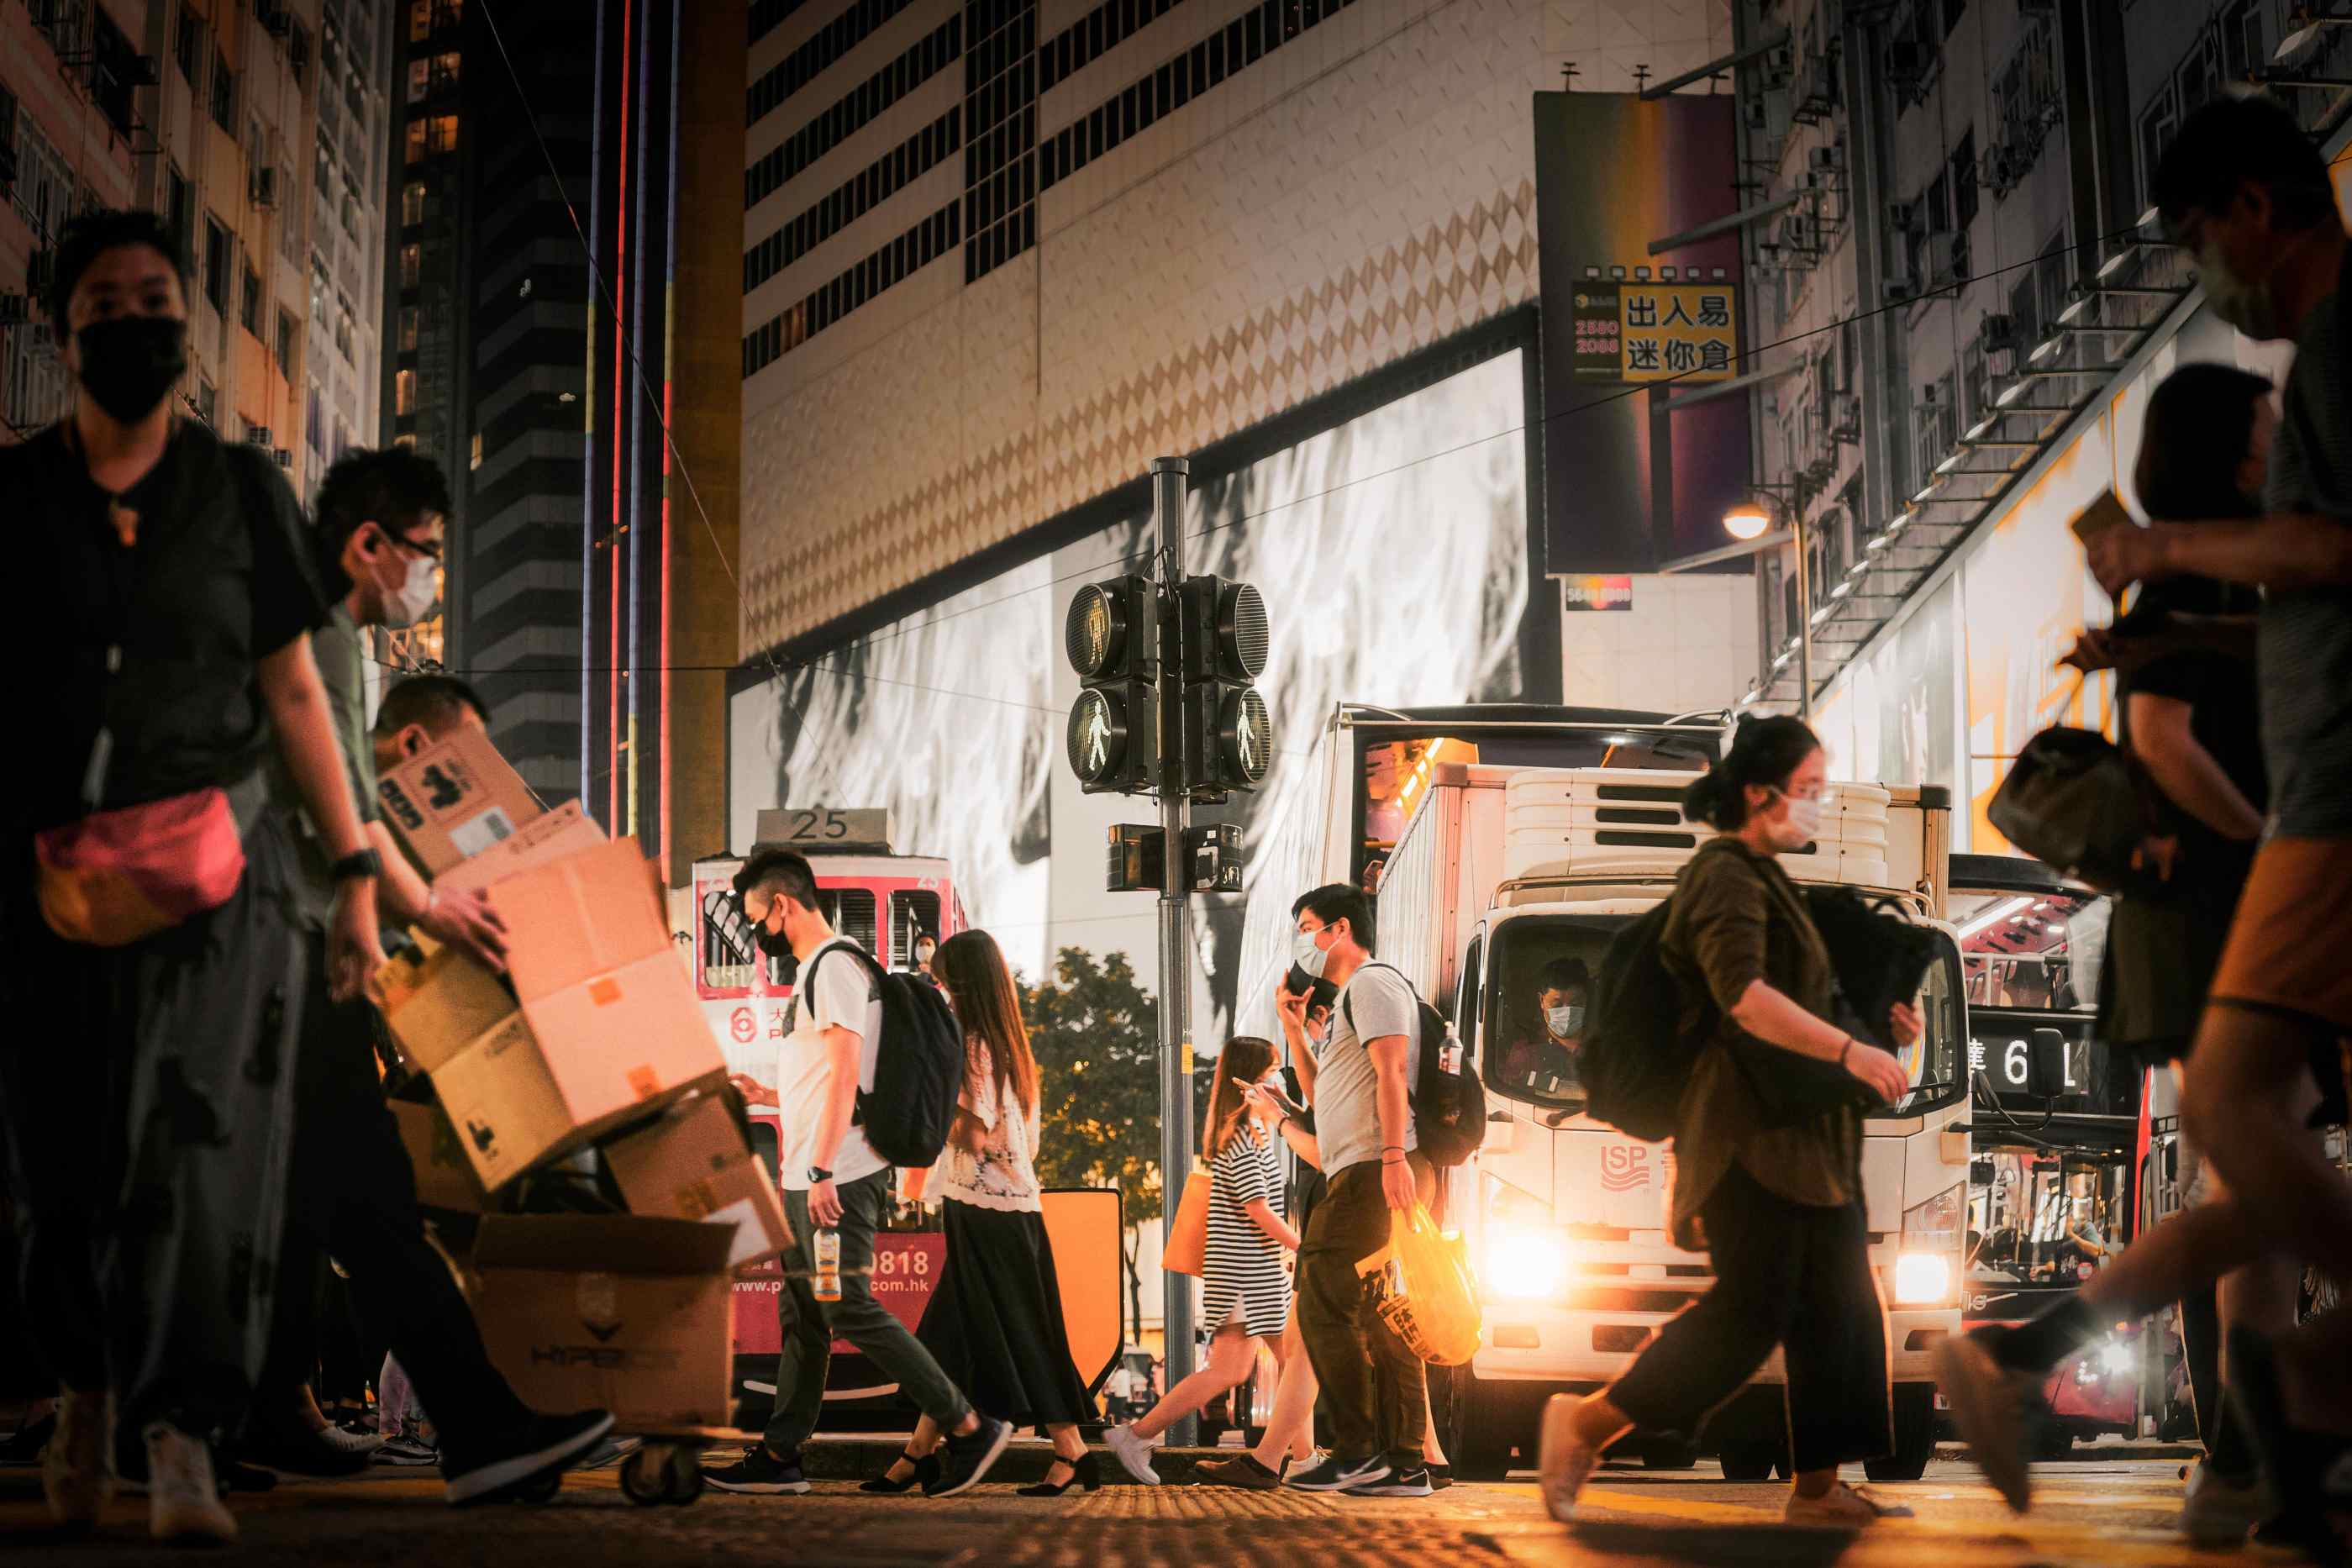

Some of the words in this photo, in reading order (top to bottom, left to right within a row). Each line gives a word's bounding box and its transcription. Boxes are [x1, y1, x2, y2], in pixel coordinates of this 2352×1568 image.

[1626, 294, 1730, 329] 出入易
[1626, 338, 1731, 371] 迷你倉
[791, 810, 848, 839] 25
[732, 1281, 785, 1295] www.p
[870, 1279, 929, 1292] com.hk
